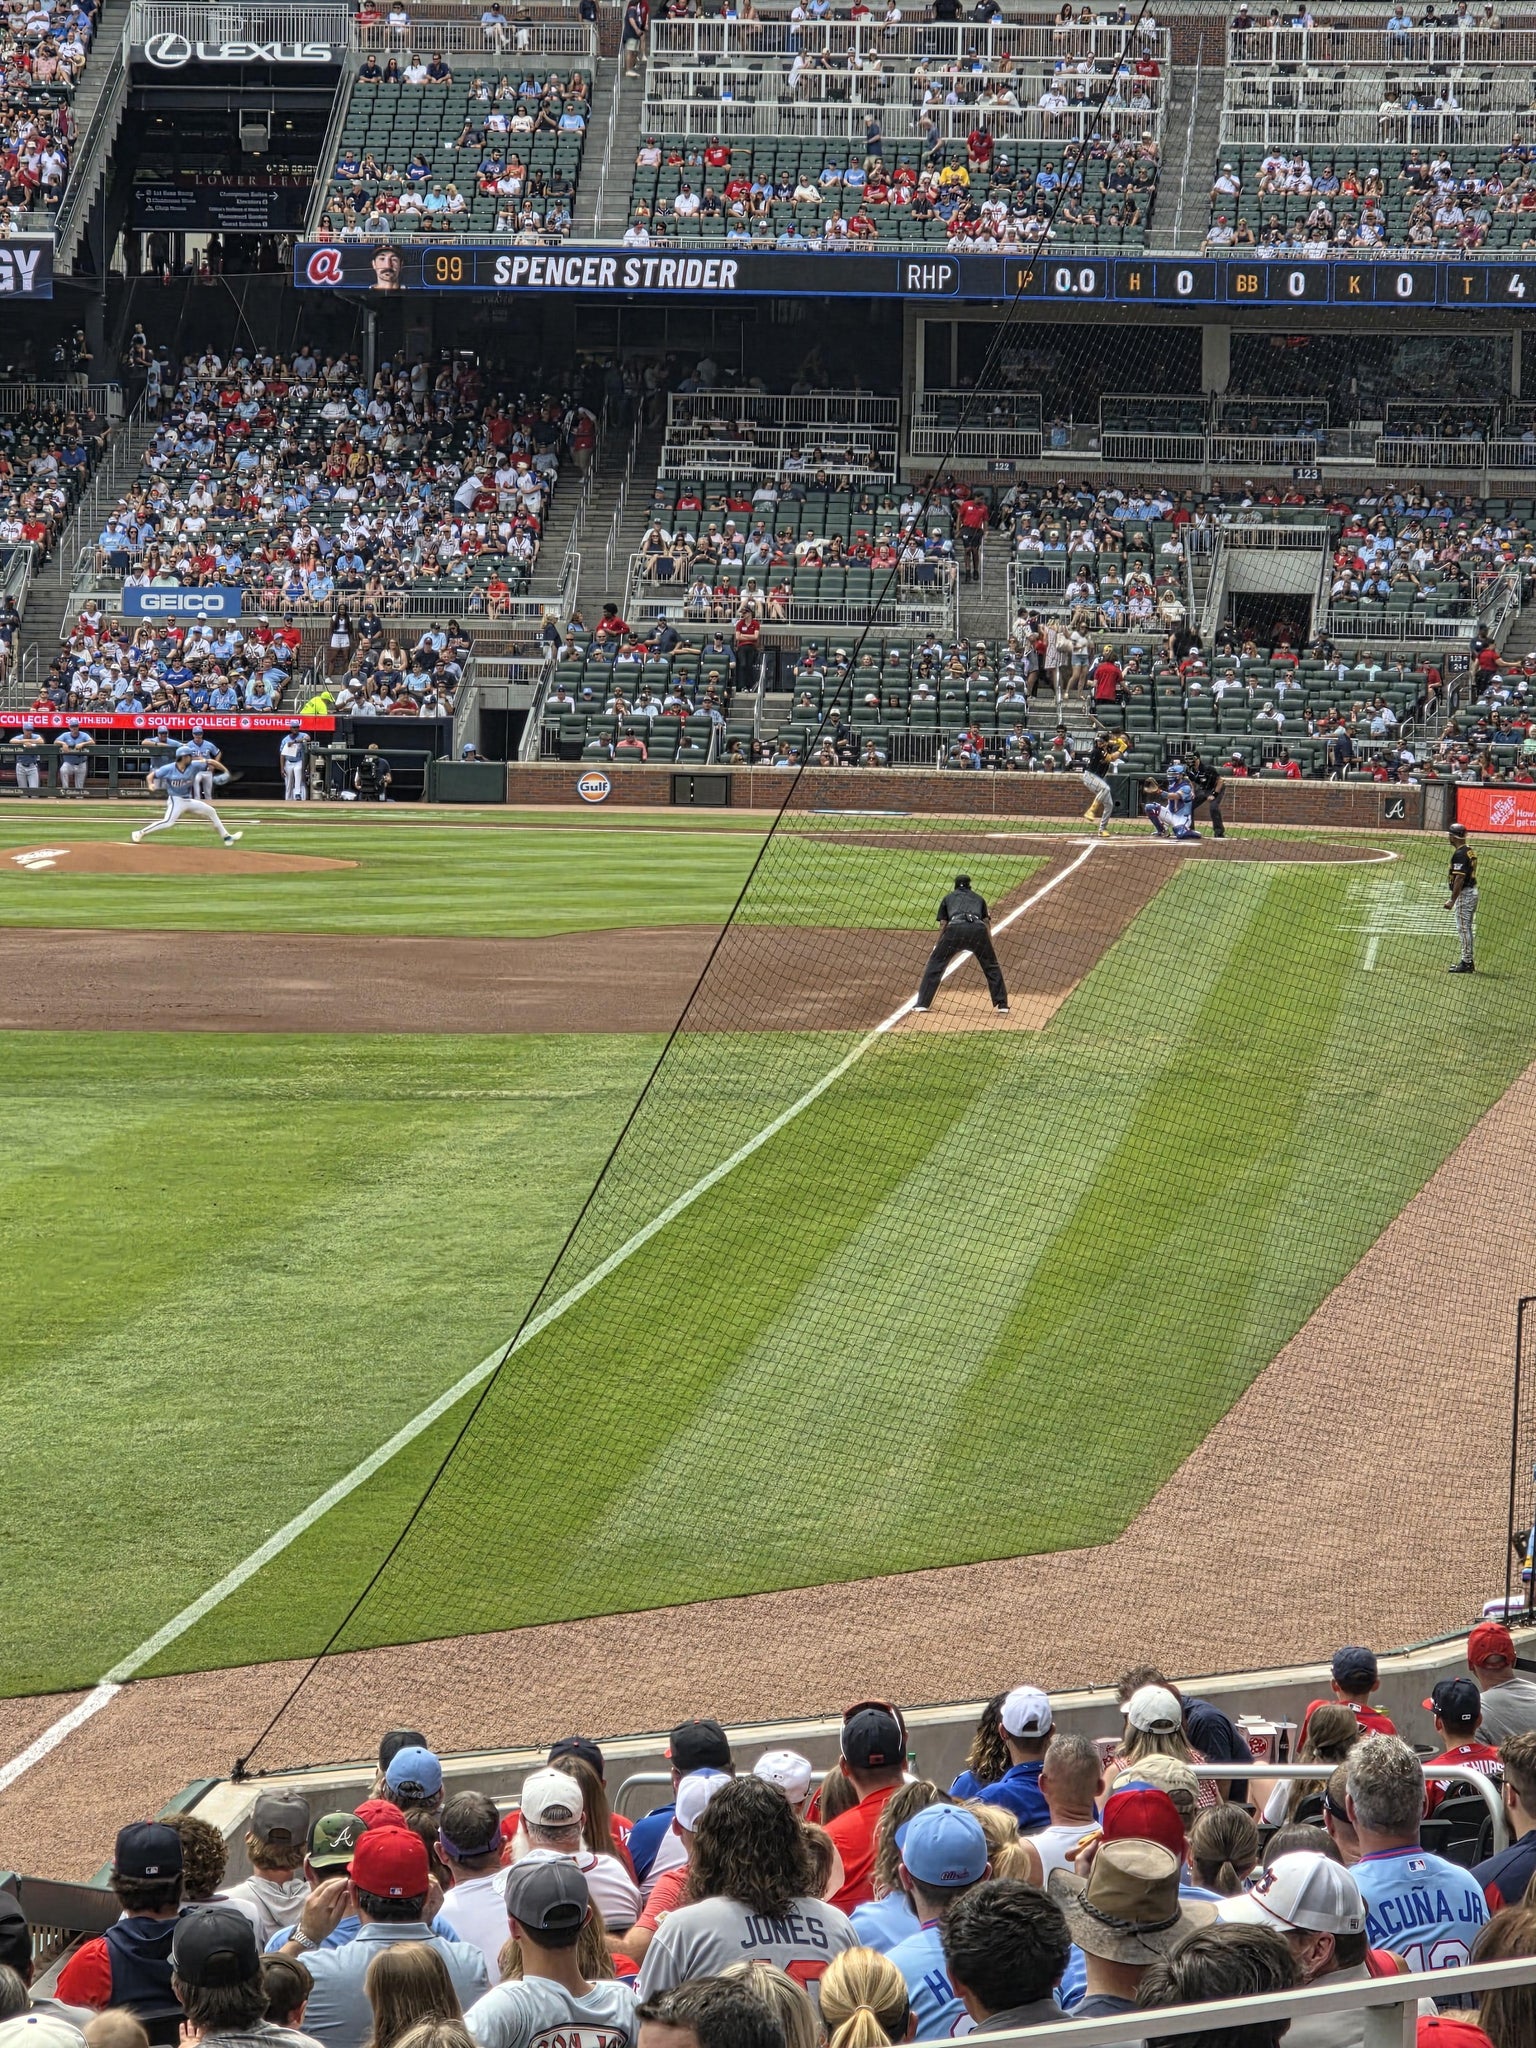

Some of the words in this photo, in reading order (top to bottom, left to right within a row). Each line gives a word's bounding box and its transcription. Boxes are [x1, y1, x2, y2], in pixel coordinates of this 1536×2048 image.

[196, 42, 332, 62] LEXUS
[195, 174, 256, 186] LOWER
[269, 175, 313, 187] LEVE
[436, 256, 463, 282] 99
[493, 255, 617, 286] SPENCER
[624, 257, 738, 288] STRIDER
[908, 264, 951, 289] RHP
[1055, 268, 1096, 292] 0.0
[1129, 272, 1141, 291] H
[1177, 270, 1194, 294] 0
[1236, 274, 1259, 293] BB
[1289, 272, 1306, 296] 0
[1349, 275, 1361, 294] K
[1397, 272, 1414, 297] 0
[1463, 276, 1474, 295] T
[1507, 274, 1526, 298] 4
[1297, 469, 1318, 479] 123
[140, 593, 225, 611] GEICO
[0, 715, 49, 724] COLLEGE
[148, 717, 185, 726] SOUTH
[188, 717, 237, 727] COLLEGE
[253, 718, 303, 727] SOUTH.EU
[580, 781, 608, 792] Gulf
[329, 1825, 354, 1848] A
[1365, 1885, 1455, 1946] ACUÑA
[740, 1913, 829, 1949] JONES
